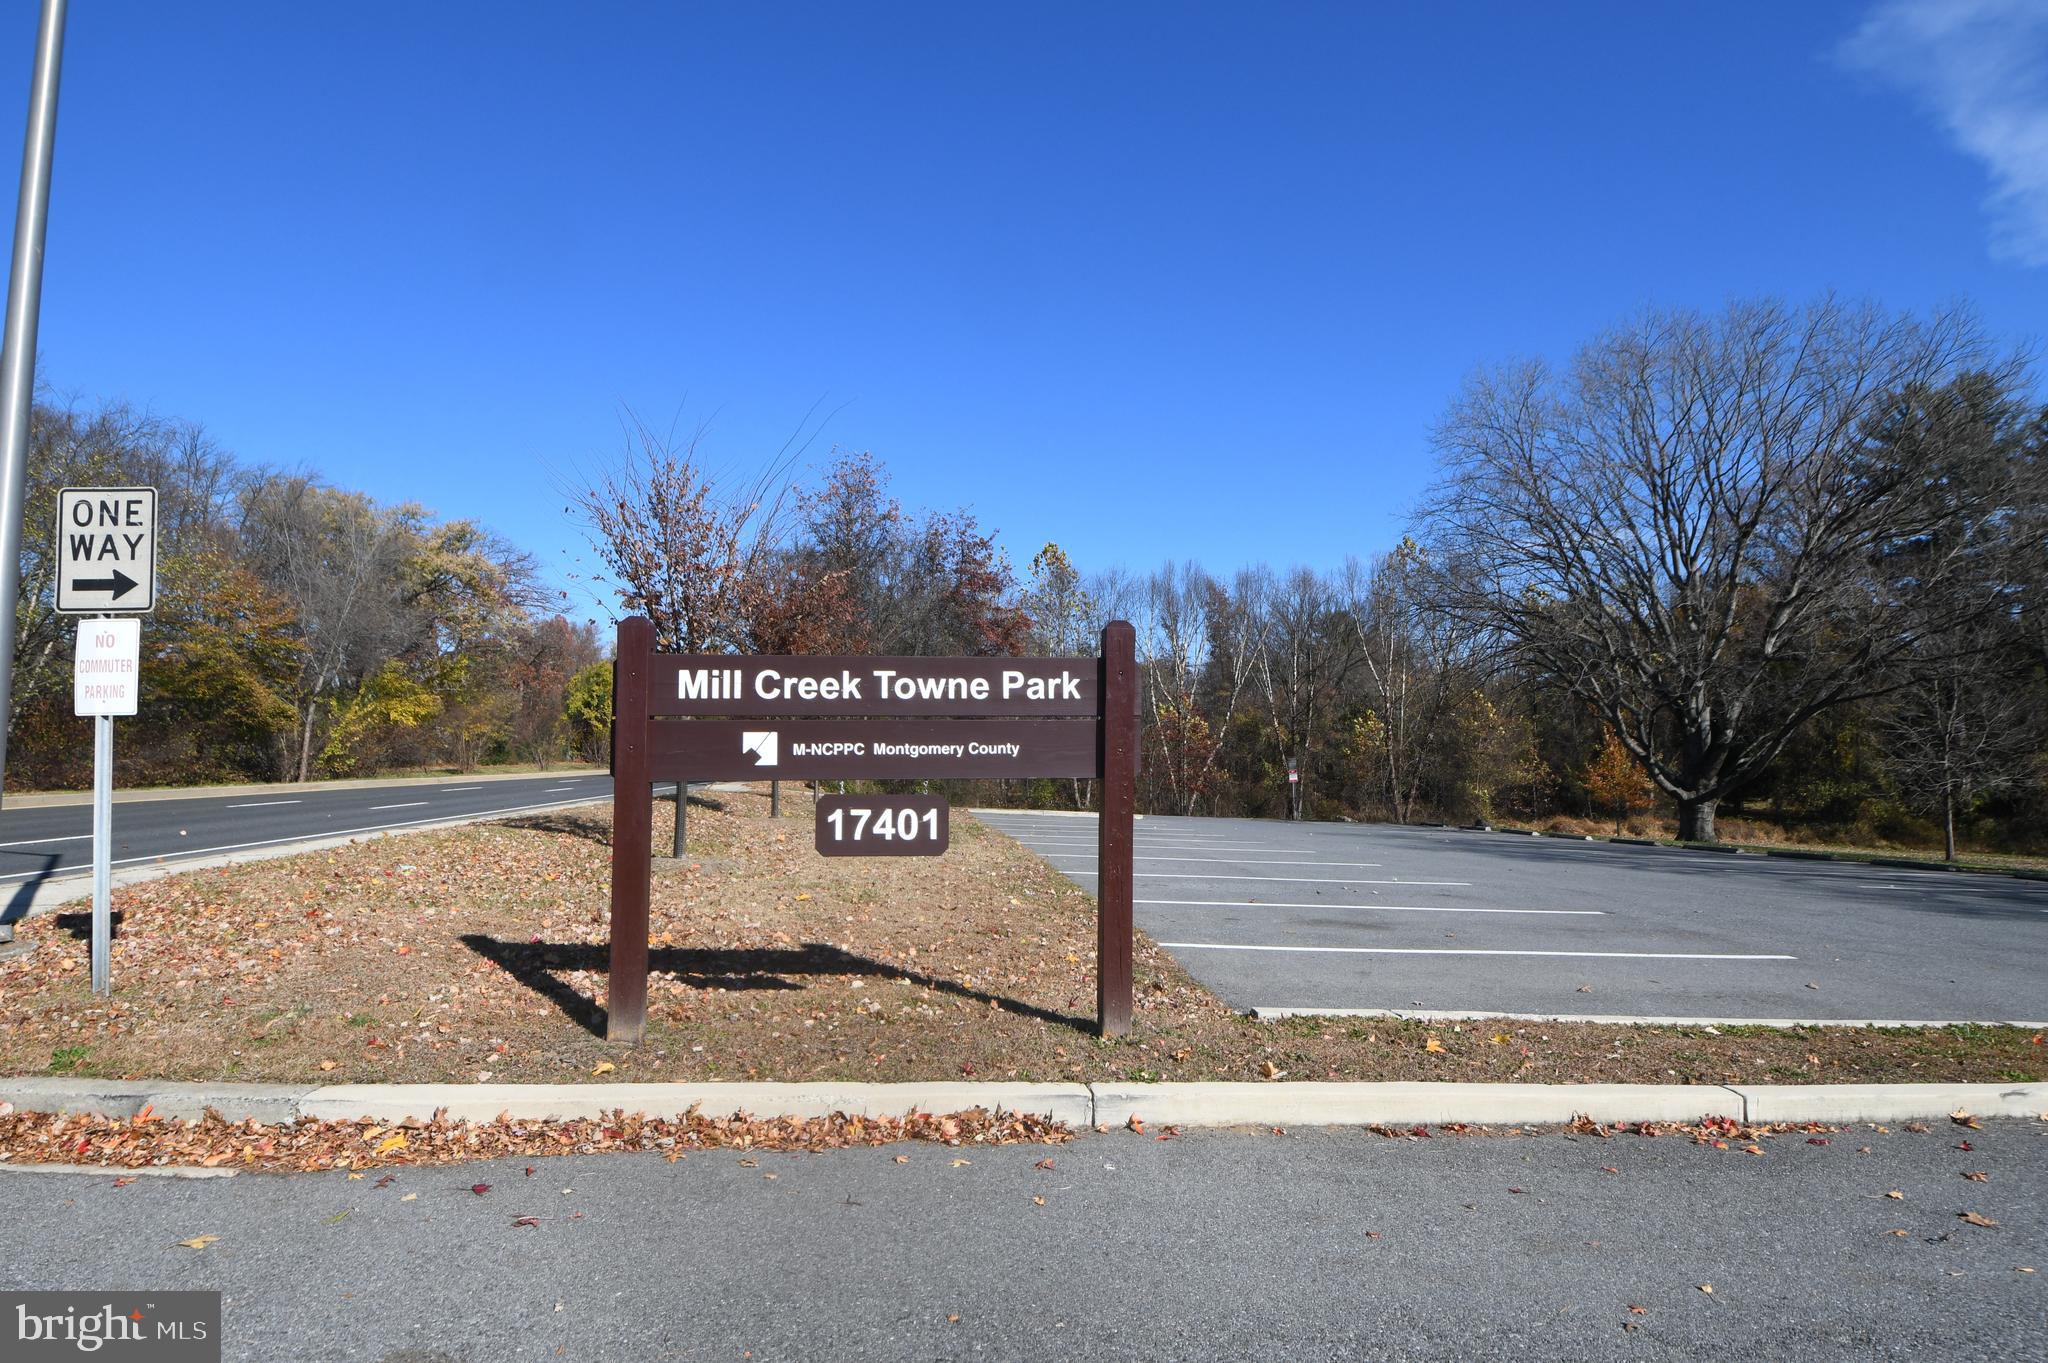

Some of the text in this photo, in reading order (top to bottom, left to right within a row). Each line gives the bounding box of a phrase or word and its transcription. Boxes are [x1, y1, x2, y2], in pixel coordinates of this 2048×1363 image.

[72, 499, 143, 527] ONE
[69, 533, 145, 561] WAY
[95, 634, 116, 649] NO
[79, 659, 133, 674] COMMUTER
[84, 684, 126, 699] PARKING
[677, 669, 1081, 700] Mill Creek Towne Park
[792, 741, 1020, 760] M-NCPPC Montgomery County
[826, 807, 939, 842] 17401
